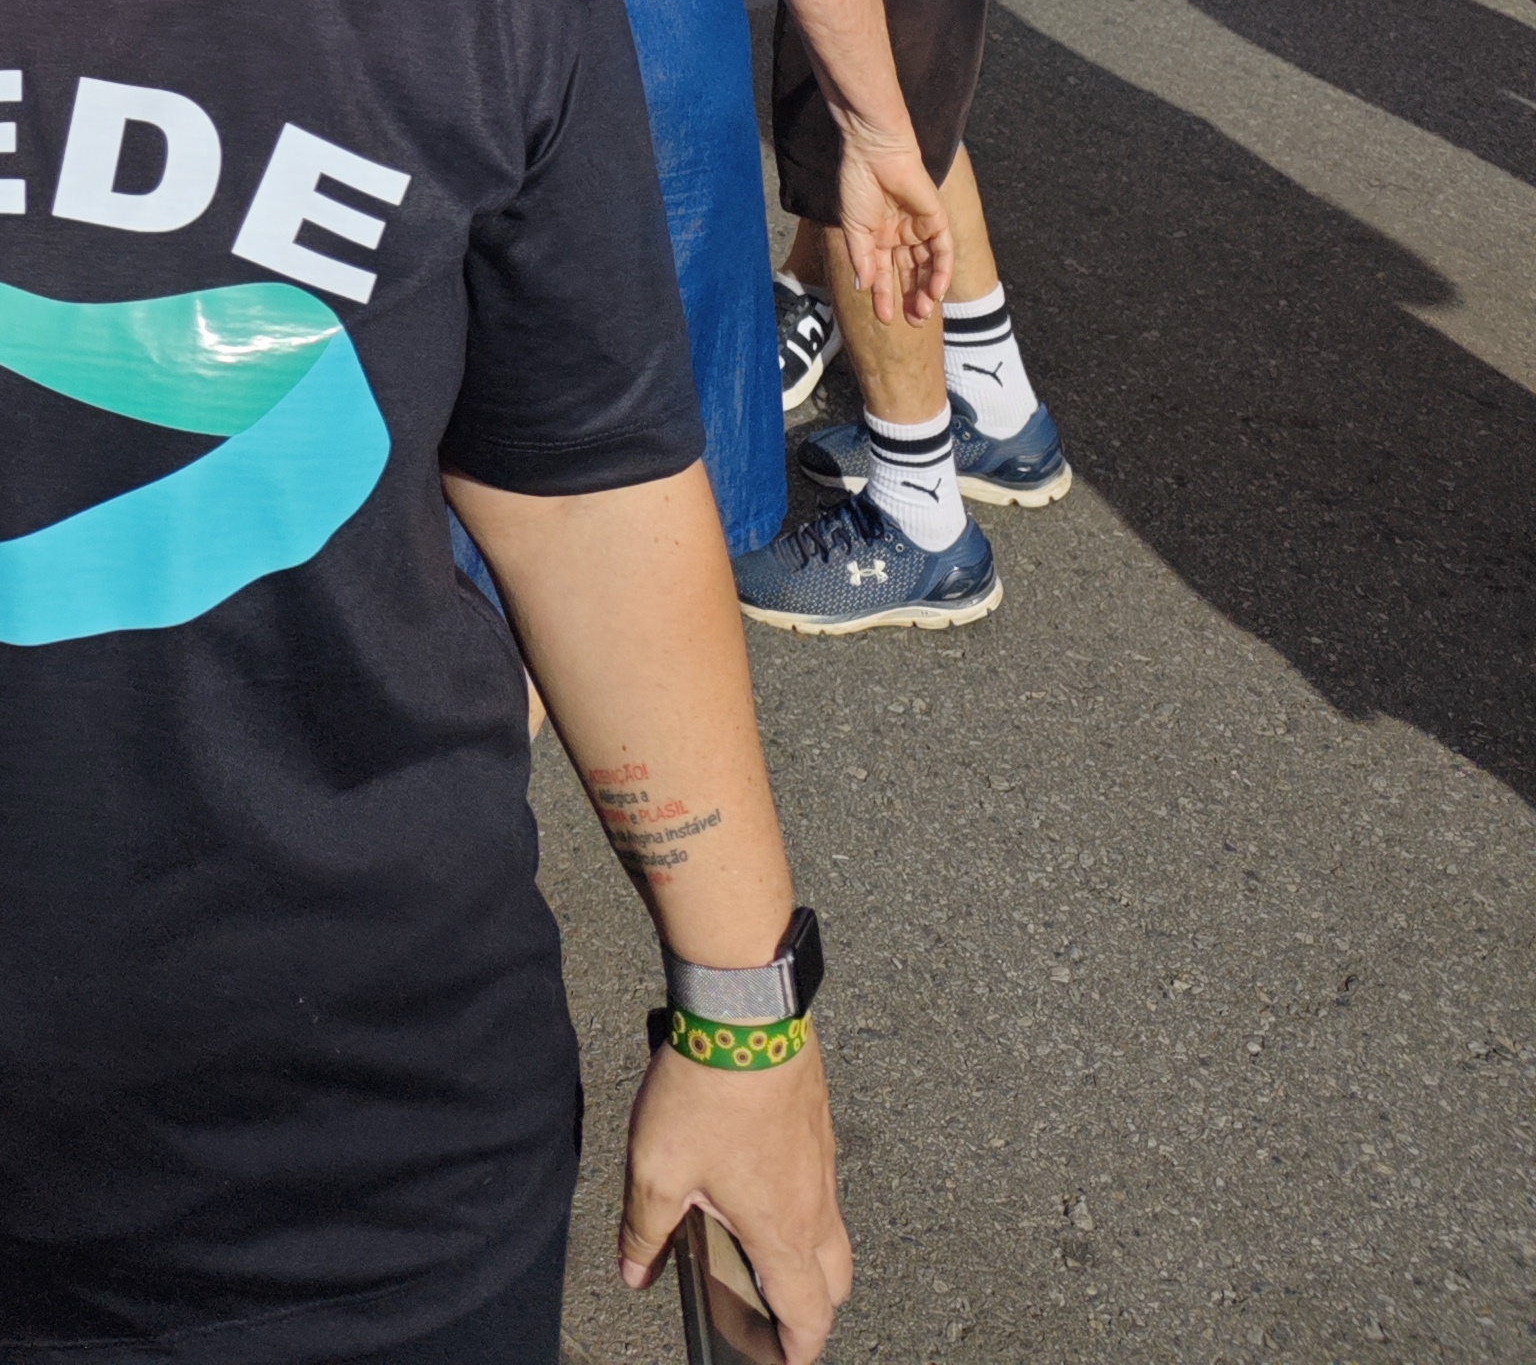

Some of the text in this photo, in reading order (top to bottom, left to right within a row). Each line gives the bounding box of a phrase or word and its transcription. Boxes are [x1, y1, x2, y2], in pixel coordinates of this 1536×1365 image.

[641, 790, 649, 803] a
[639, 800, 689, 823] PLASIL
[665, 808, 722, 841] instável
